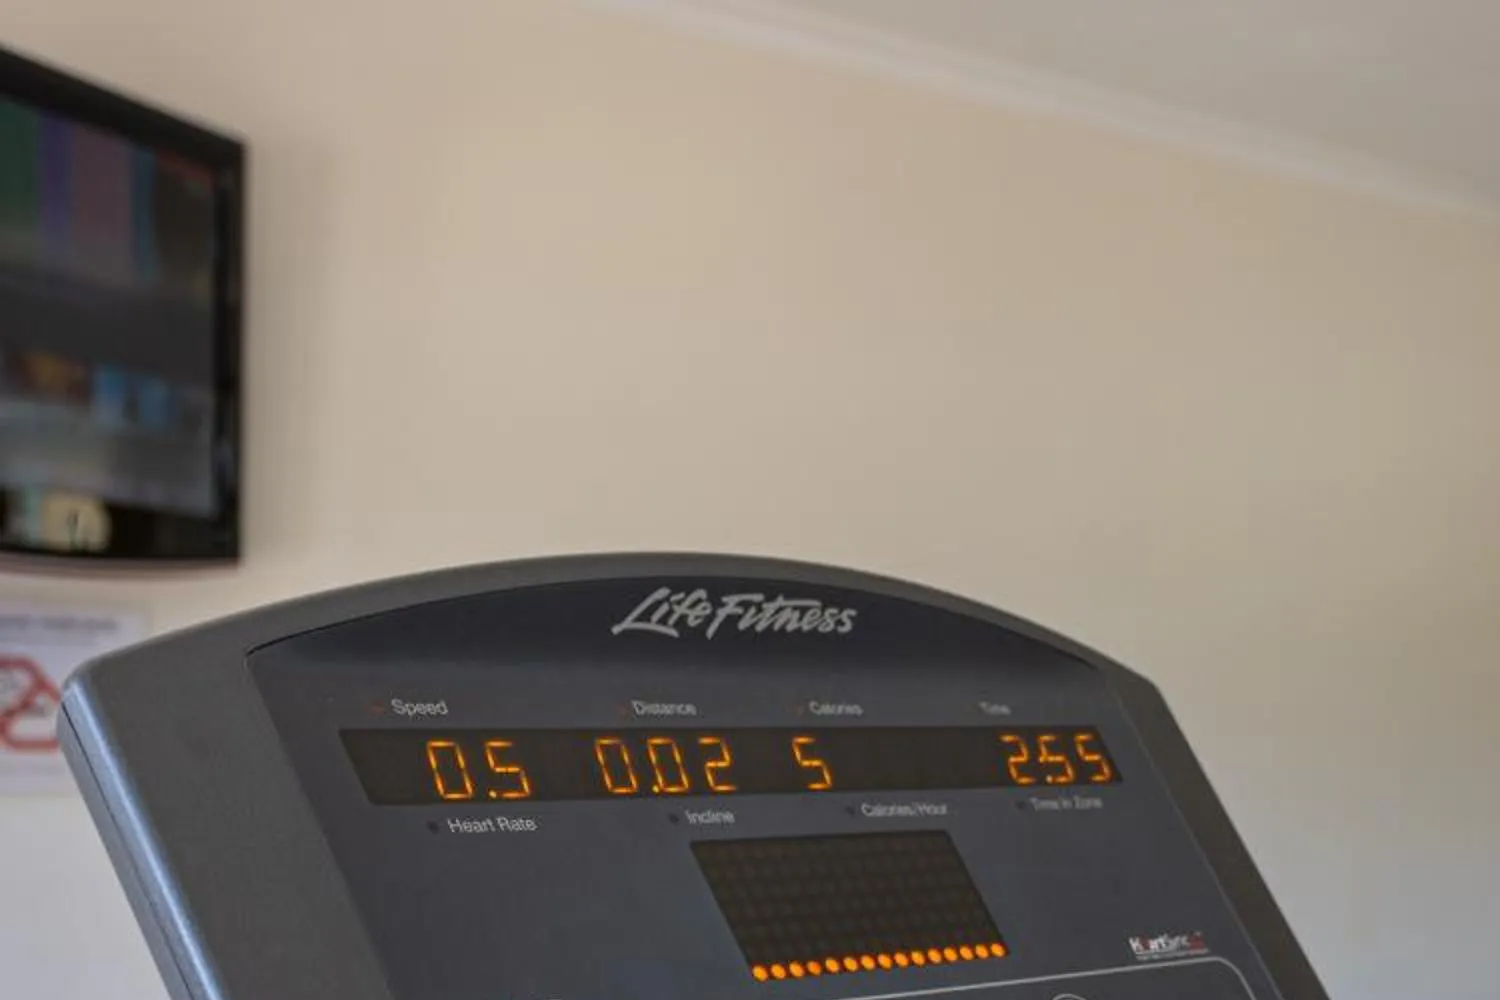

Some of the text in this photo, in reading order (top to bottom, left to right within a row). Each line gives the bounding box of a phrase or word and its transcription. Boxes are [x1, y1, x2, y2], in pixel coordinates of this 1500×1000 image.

[611, 586, 857, 640] Life Fitness
[391, 698, 449, 717] Speed
[631, 700, 697, 716] Distance
[808, 700, 864, 716] Calories
[426, 740, 531, 799] 0.5
[595, 737, 737, 793] 0.02
[792, 737, 833, 790] 5
[447, 816, 538, 834] Heart Rate
[685, 810, 736, 825] Incline
